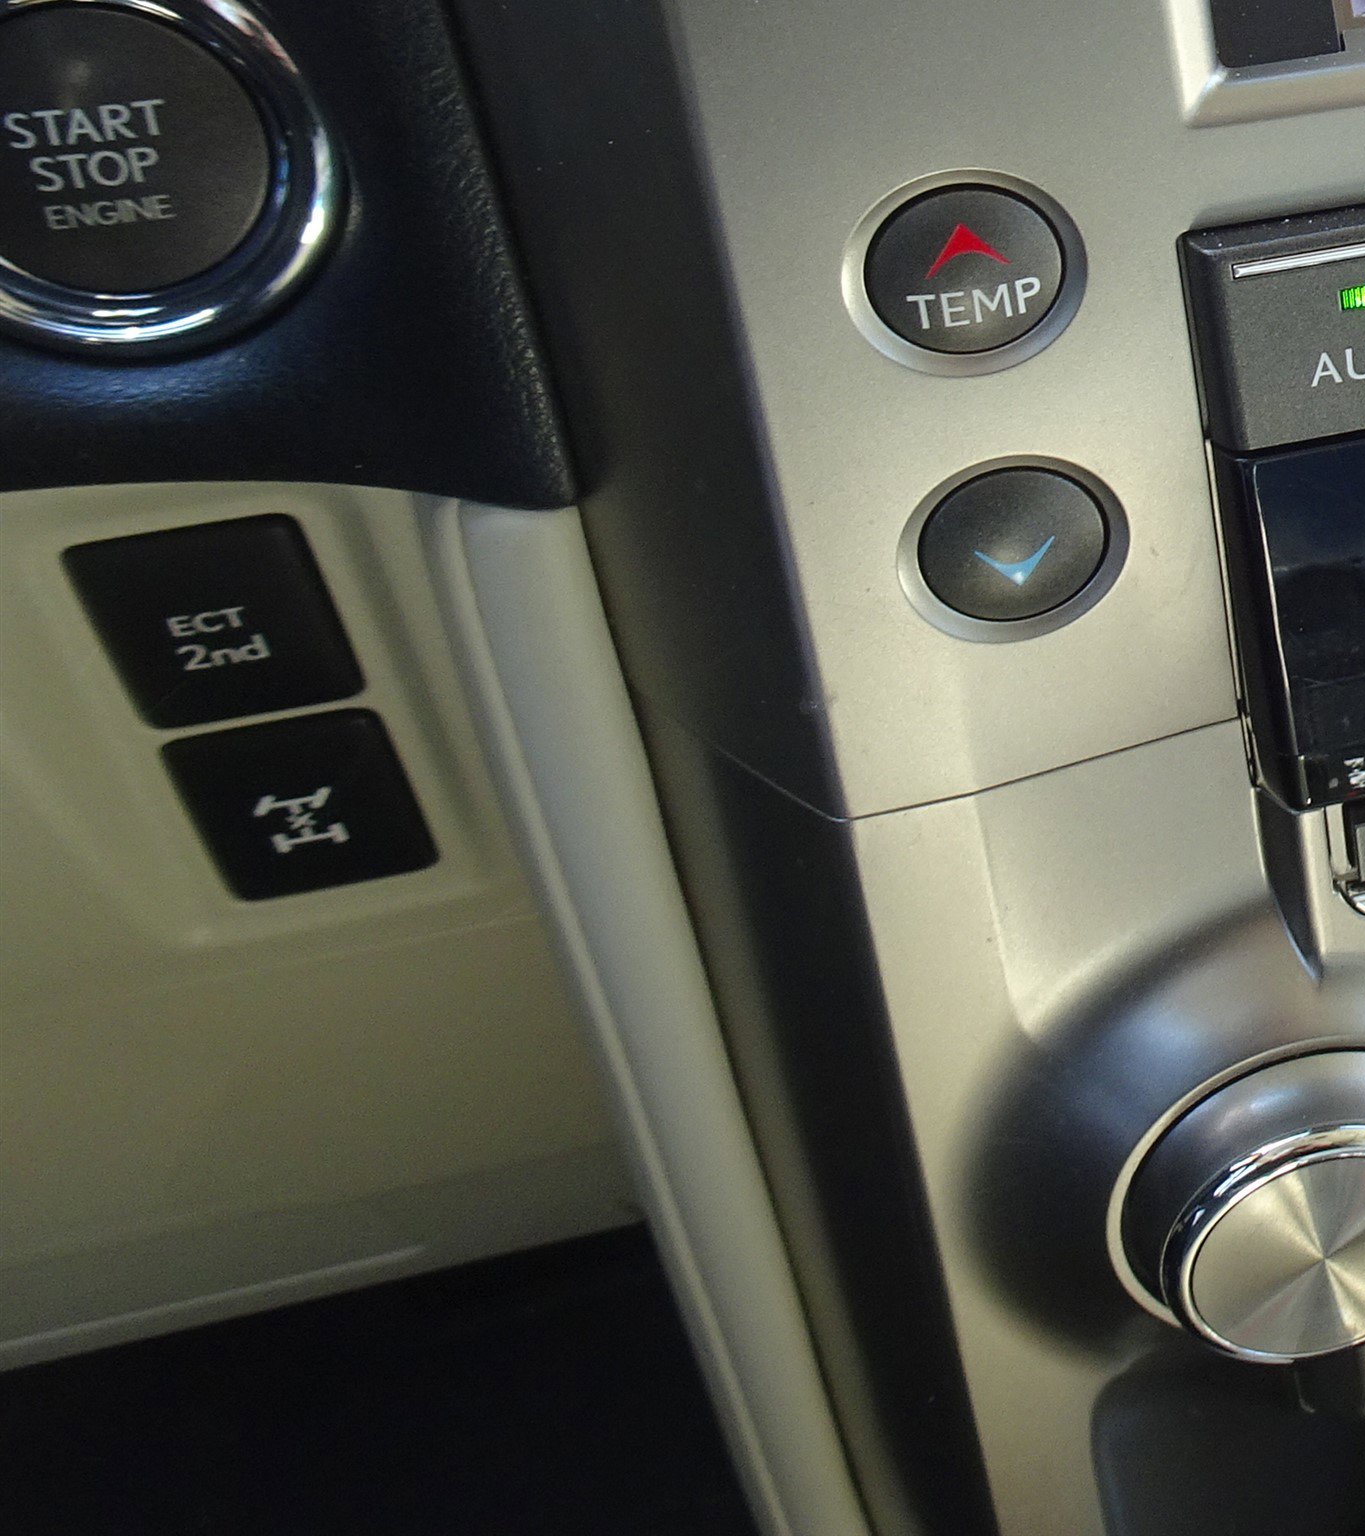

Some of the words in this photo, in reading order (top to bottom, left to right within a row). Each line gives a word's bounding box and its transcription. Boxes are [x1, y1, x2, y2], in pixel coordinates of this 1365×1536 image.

[2, 98, 166, 150] START
[30, 146, 160, 192] STOP
[44, 194, 177, 230] ENGINE
[906, 276, 1042, 330] TEMP
[165, 606, 245, 638] ECT
[174, 633, 272, 671] 2nd
